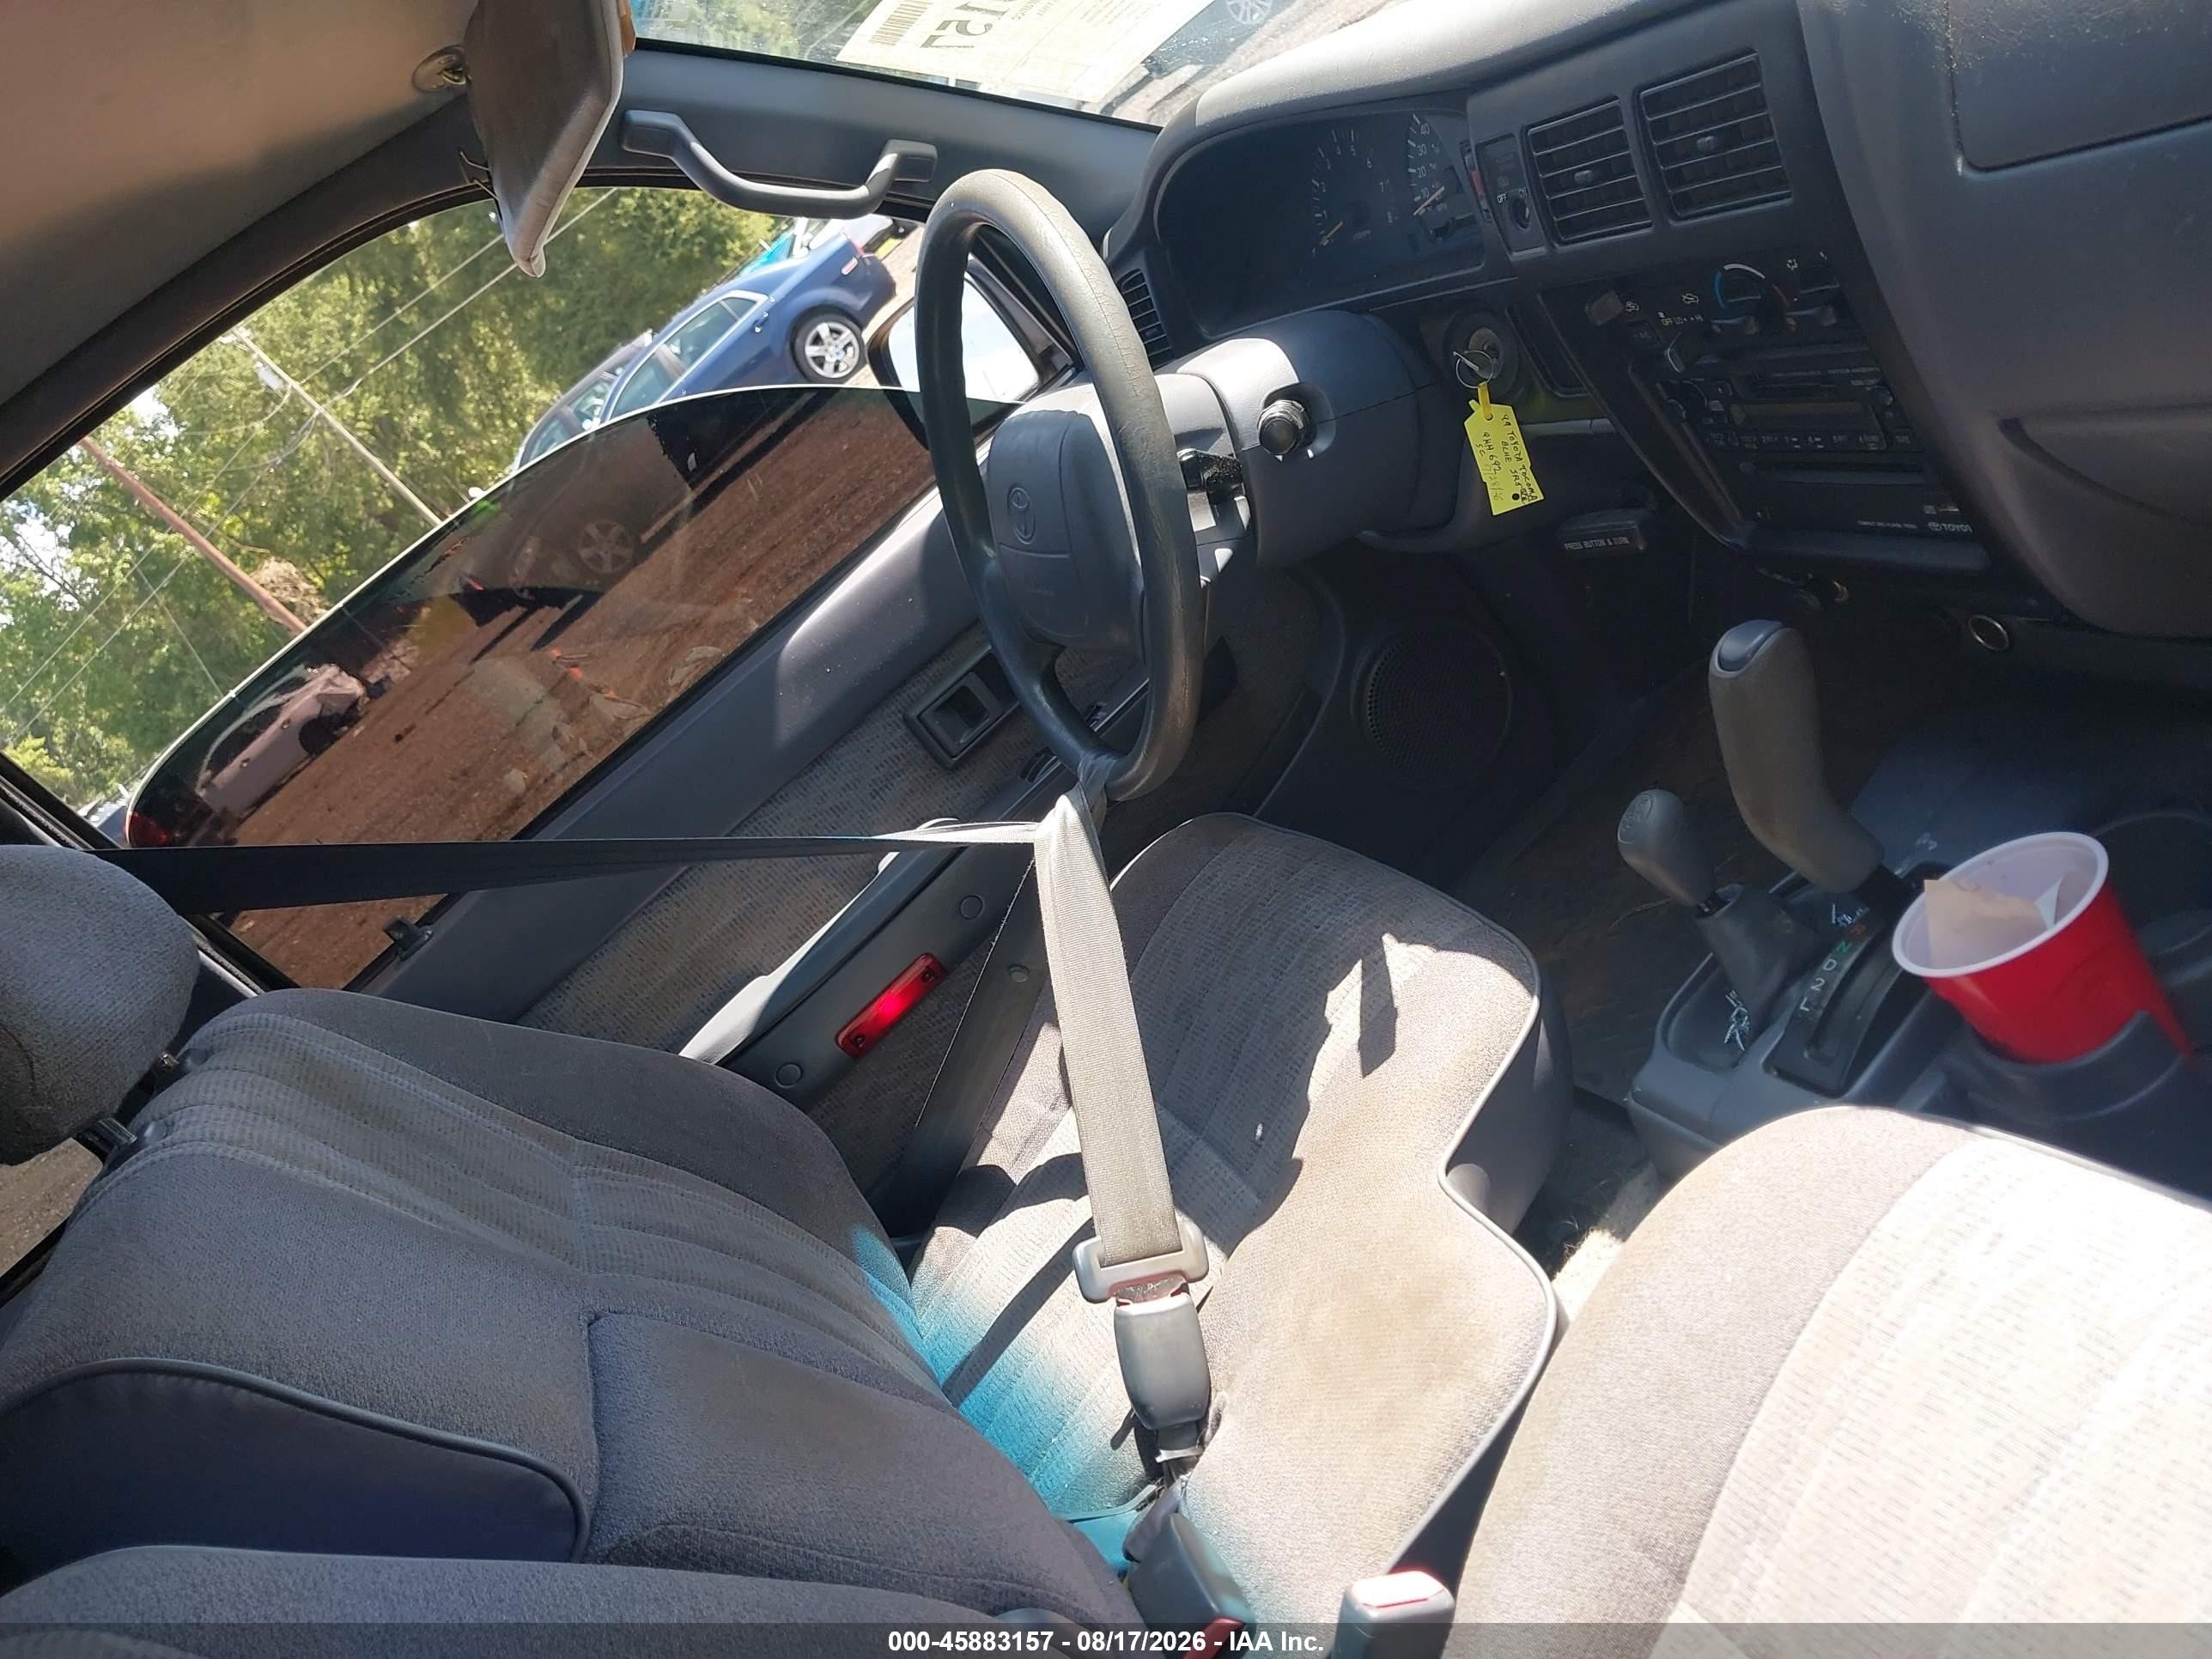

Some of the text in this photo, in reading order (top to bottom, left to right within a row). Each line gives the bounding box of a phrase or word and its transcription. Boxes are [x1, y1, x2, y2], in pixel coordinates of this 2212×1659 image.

[1420, 123, 1430, 135] 40
[1417, 144, 1427, 156] 30
[1417, 166, 1426, 179] 20
[1506, 430, 1523, 462] TOYOTA
[1489, 454, 1503, 476] 692
[1836, 941, 1851, 955] N
[1822, 959, 1838, 972] D
[1811, 978, 1826, 991] 2
[1799, 998, 1811, 1012] L
